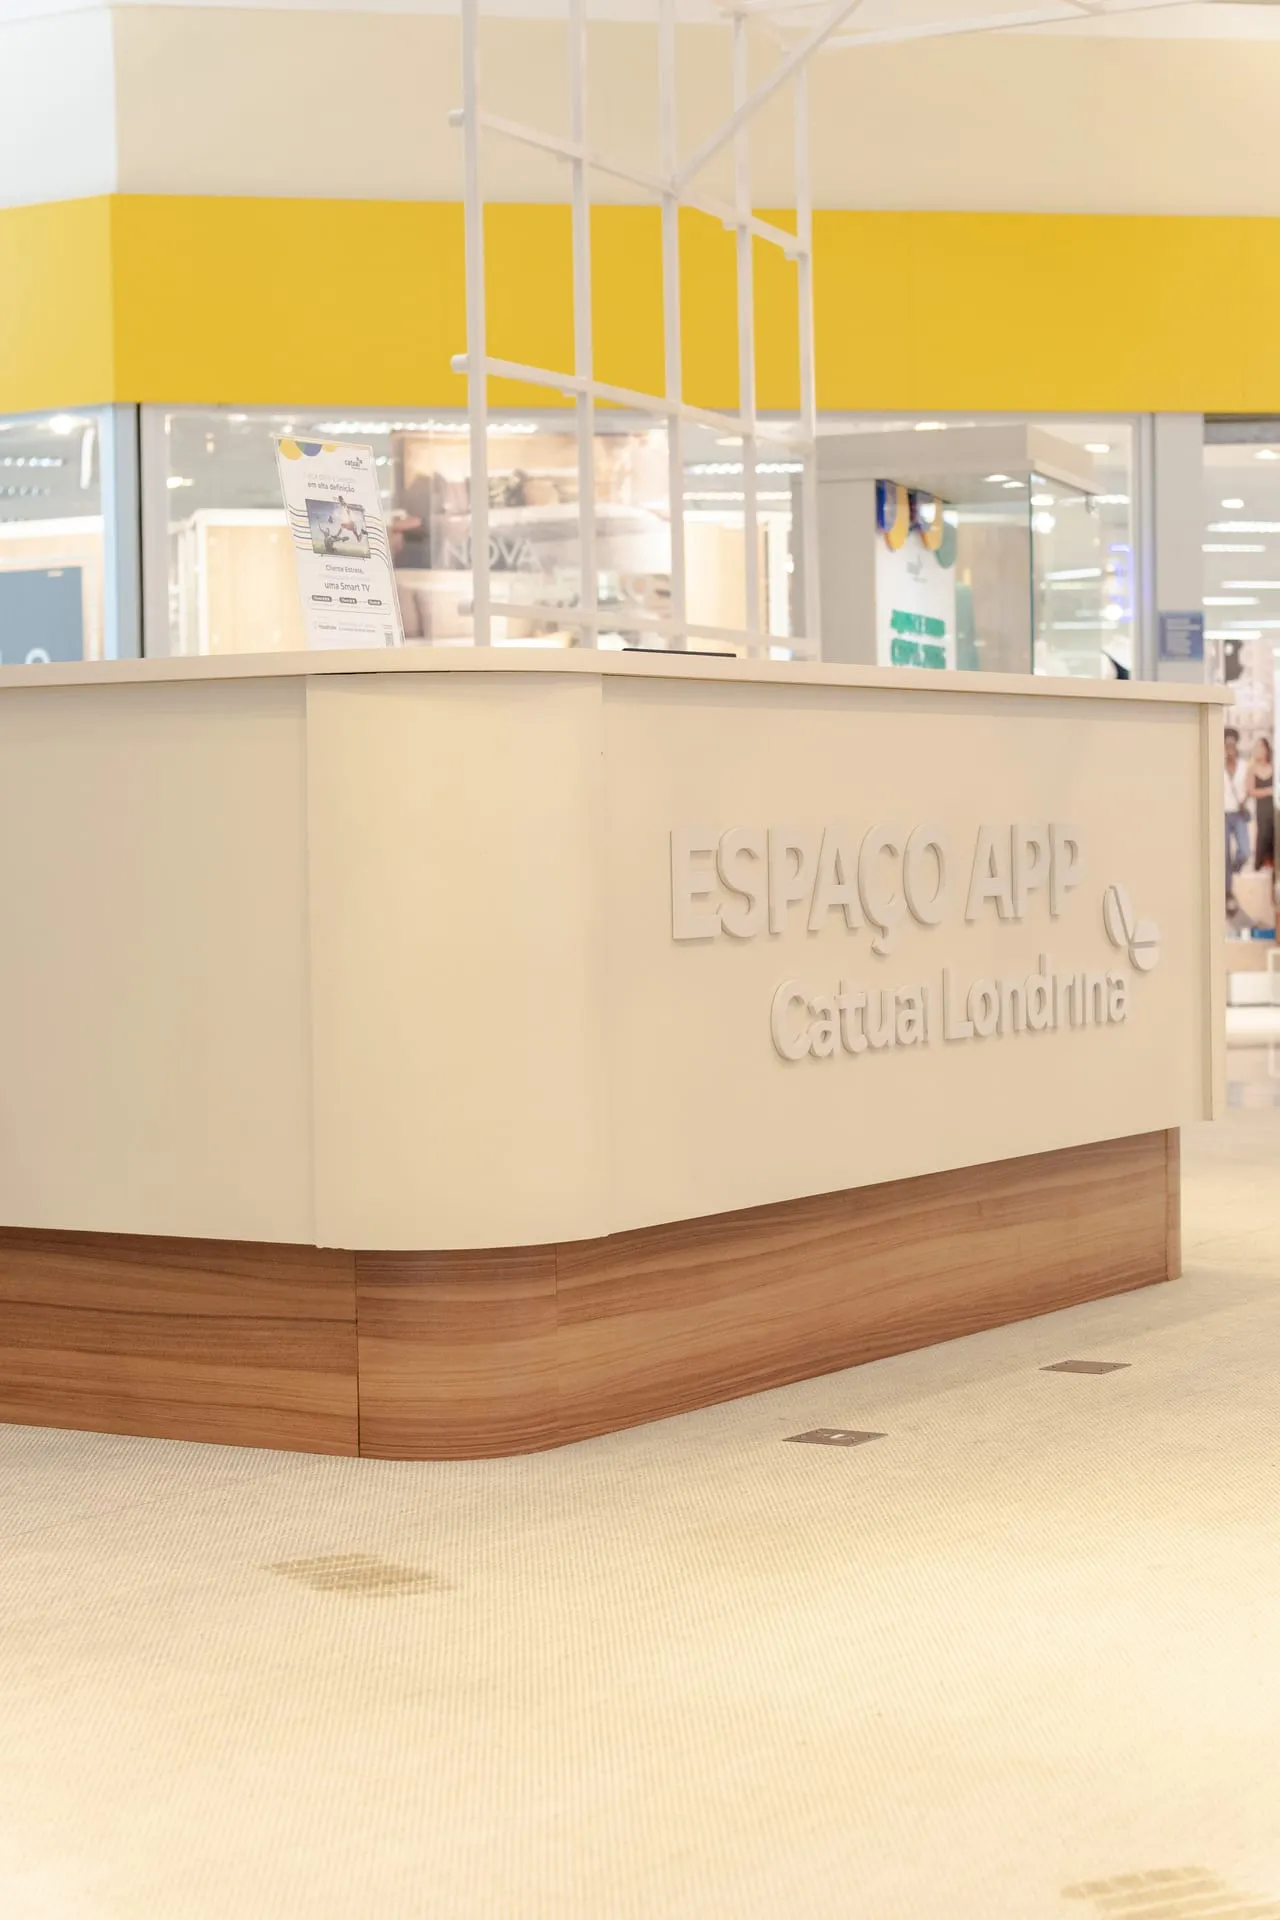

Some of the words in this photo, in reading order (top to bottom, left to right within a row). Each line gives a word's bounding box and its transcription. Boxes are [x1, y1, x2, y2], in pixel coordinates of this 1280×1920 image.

[318, 482, 329, 490] alta
[330, 484, 355, 494] definição
[324, 582, 340, 590] uma
[340, 582, 360, 592] Smart
[361, 583, 371, 593] TV
[670, 823, 948, 955] ESPAÇO
[964, 822, 1087, 921] APP
[942, 952, 1132, 1040] Londrina
